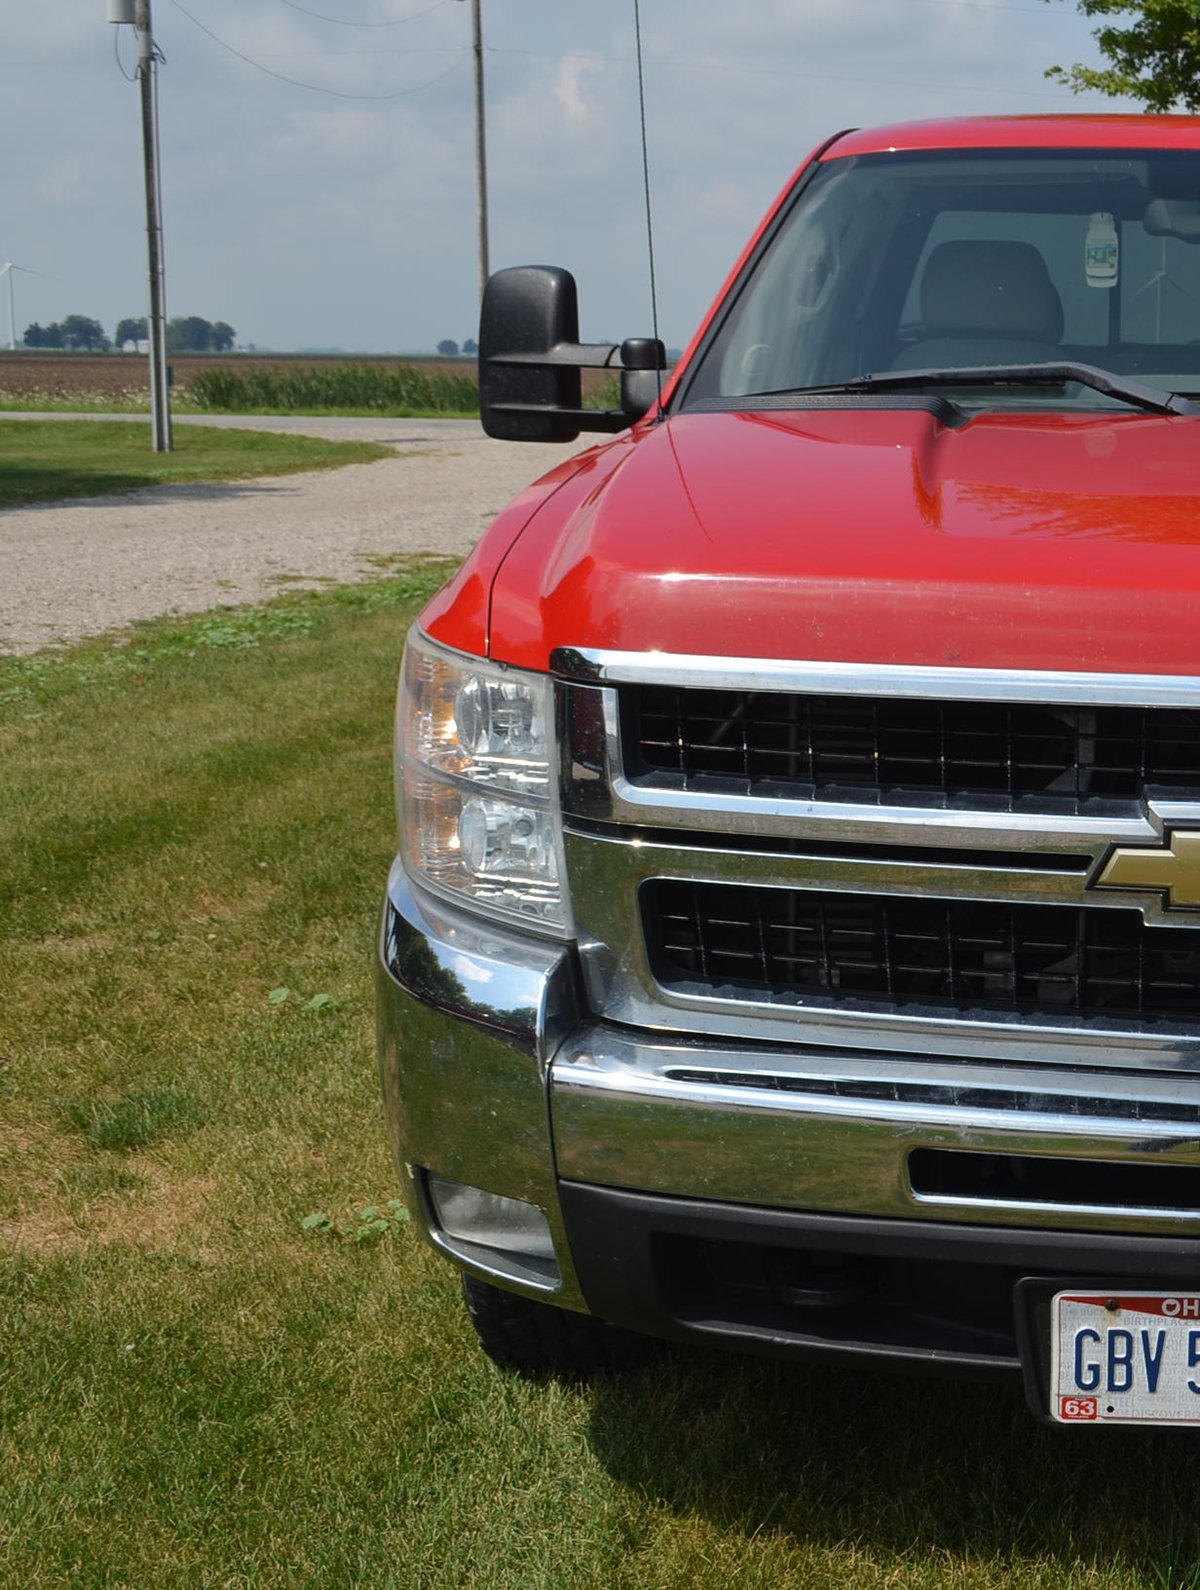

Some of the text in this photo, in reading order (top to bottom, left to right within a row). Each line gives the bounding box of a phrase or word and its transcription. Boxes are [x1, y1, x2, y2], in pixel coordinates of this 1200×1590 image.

[1123, 1316, 1190, 1327] BIRTHPLACE
[1074, 1328, 1166, 1393] GBV
[1065, 1400, 1095, 1416] 63
